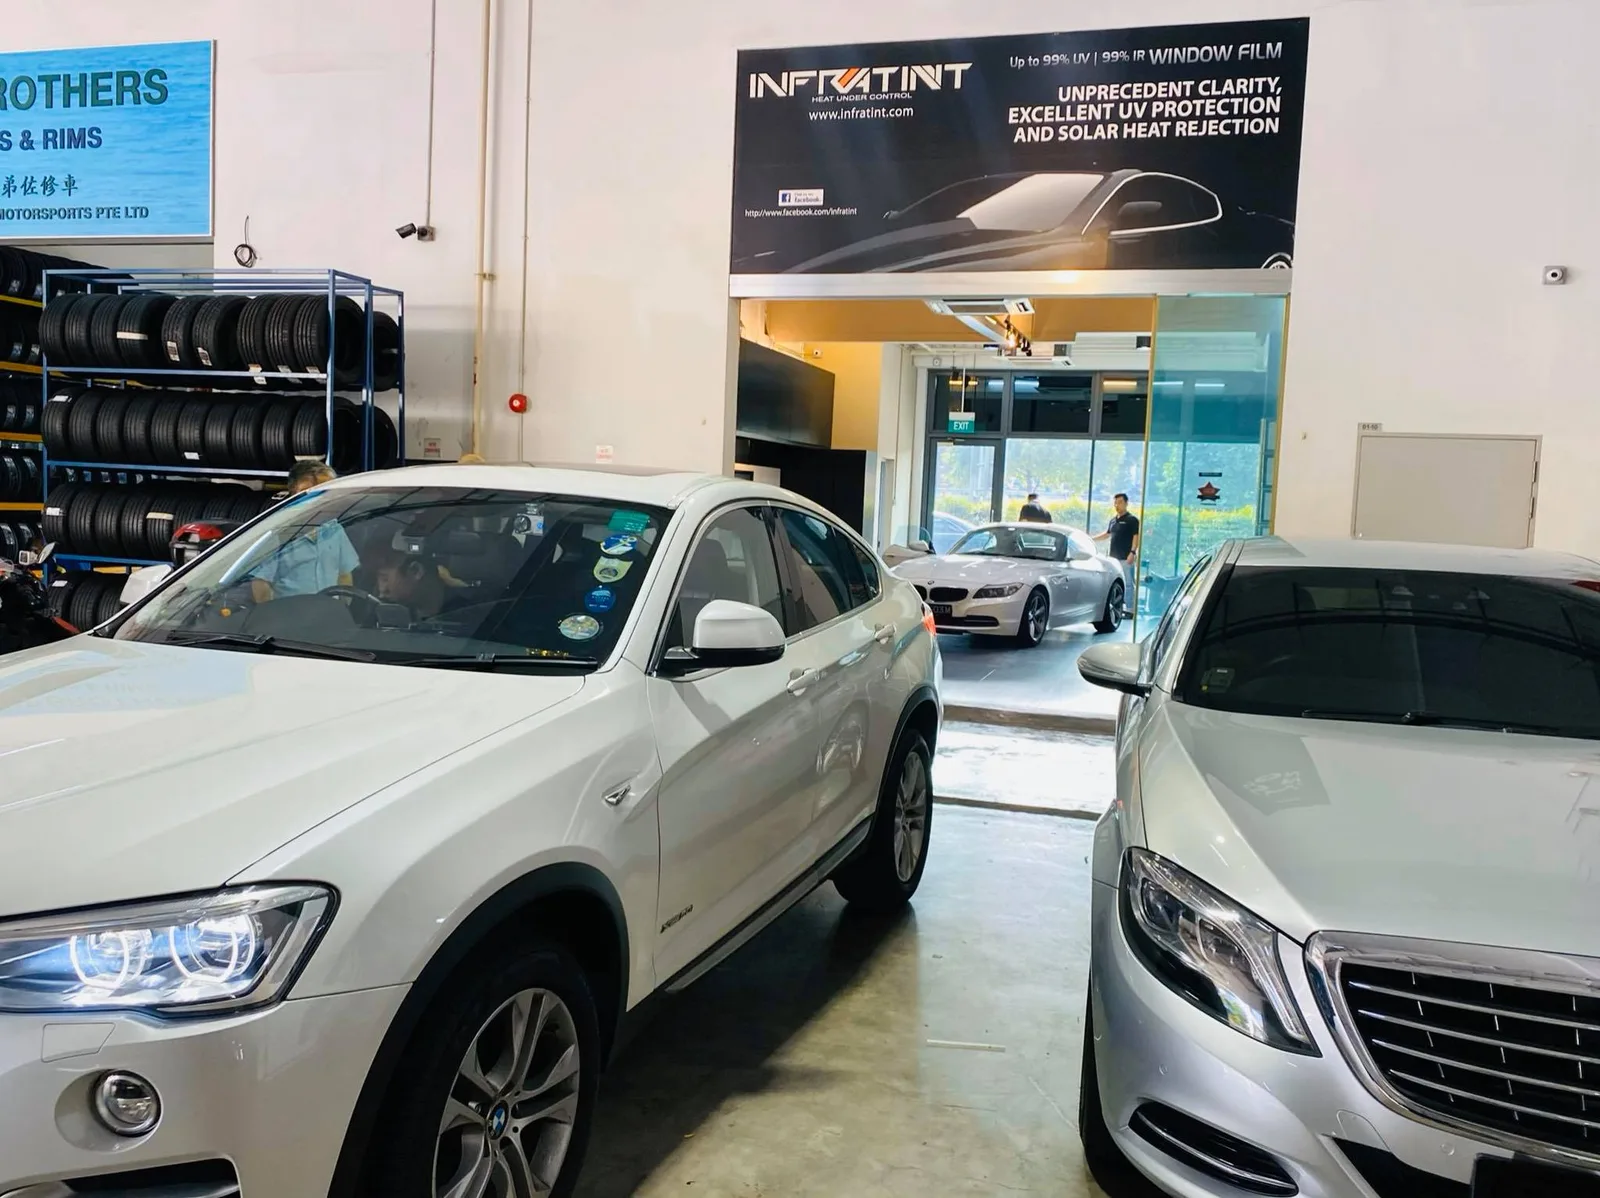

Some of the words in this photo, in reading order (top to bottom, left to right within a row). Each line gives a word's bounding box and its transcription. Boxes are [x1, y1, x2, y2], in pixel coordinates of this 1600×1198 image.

[1009, 56, 1025, 69] Up
[1028, 55, 1040, 67] to
[1042, 54, 1070, 66] 99%
[1073, 53, 1091, 65] UV
[1102, 50, 1130, 63] 99%
[1133, 50, 1146, 62] IR
[1149, 45, 1234, 65] WINDOW
[1238, 42, 1283, 61] FILM
[0, 68, 169, 111] OTHERS
[812, 95, 834, 103] HEAT
[836, 94, 868, 102] UNDER
[869, 92, 913, 100] CONTROL
[1058, 80, 1195, 102] UNPRECEDENT
[1197, 76, 1283, 96] CLARITY,
[808, 106, 914, 121] www.infratint.com
[1008, 103, 1115, 125] EXCELLENT
[1118, 102, 1150, 120] UV
[1151, 96, 1282, 118] PROTECTION
[19, 130, 35, 151] &
[42, 126, 103, 150] RIMS
[1013, 125, 1055, 143] AND
[1058, 123, 1119, 142] SOLAR
[1123, 121, 1172, 139] HEAT
[1175, 117, 1281, 137] REJECTION
[96, 206, 121, 219] PTE
[124, 206, 149, 219] LTD
[744, 207, 858, 219] http://www.facebook.com/infratint
[953, 421, 970, 431] EXIT
